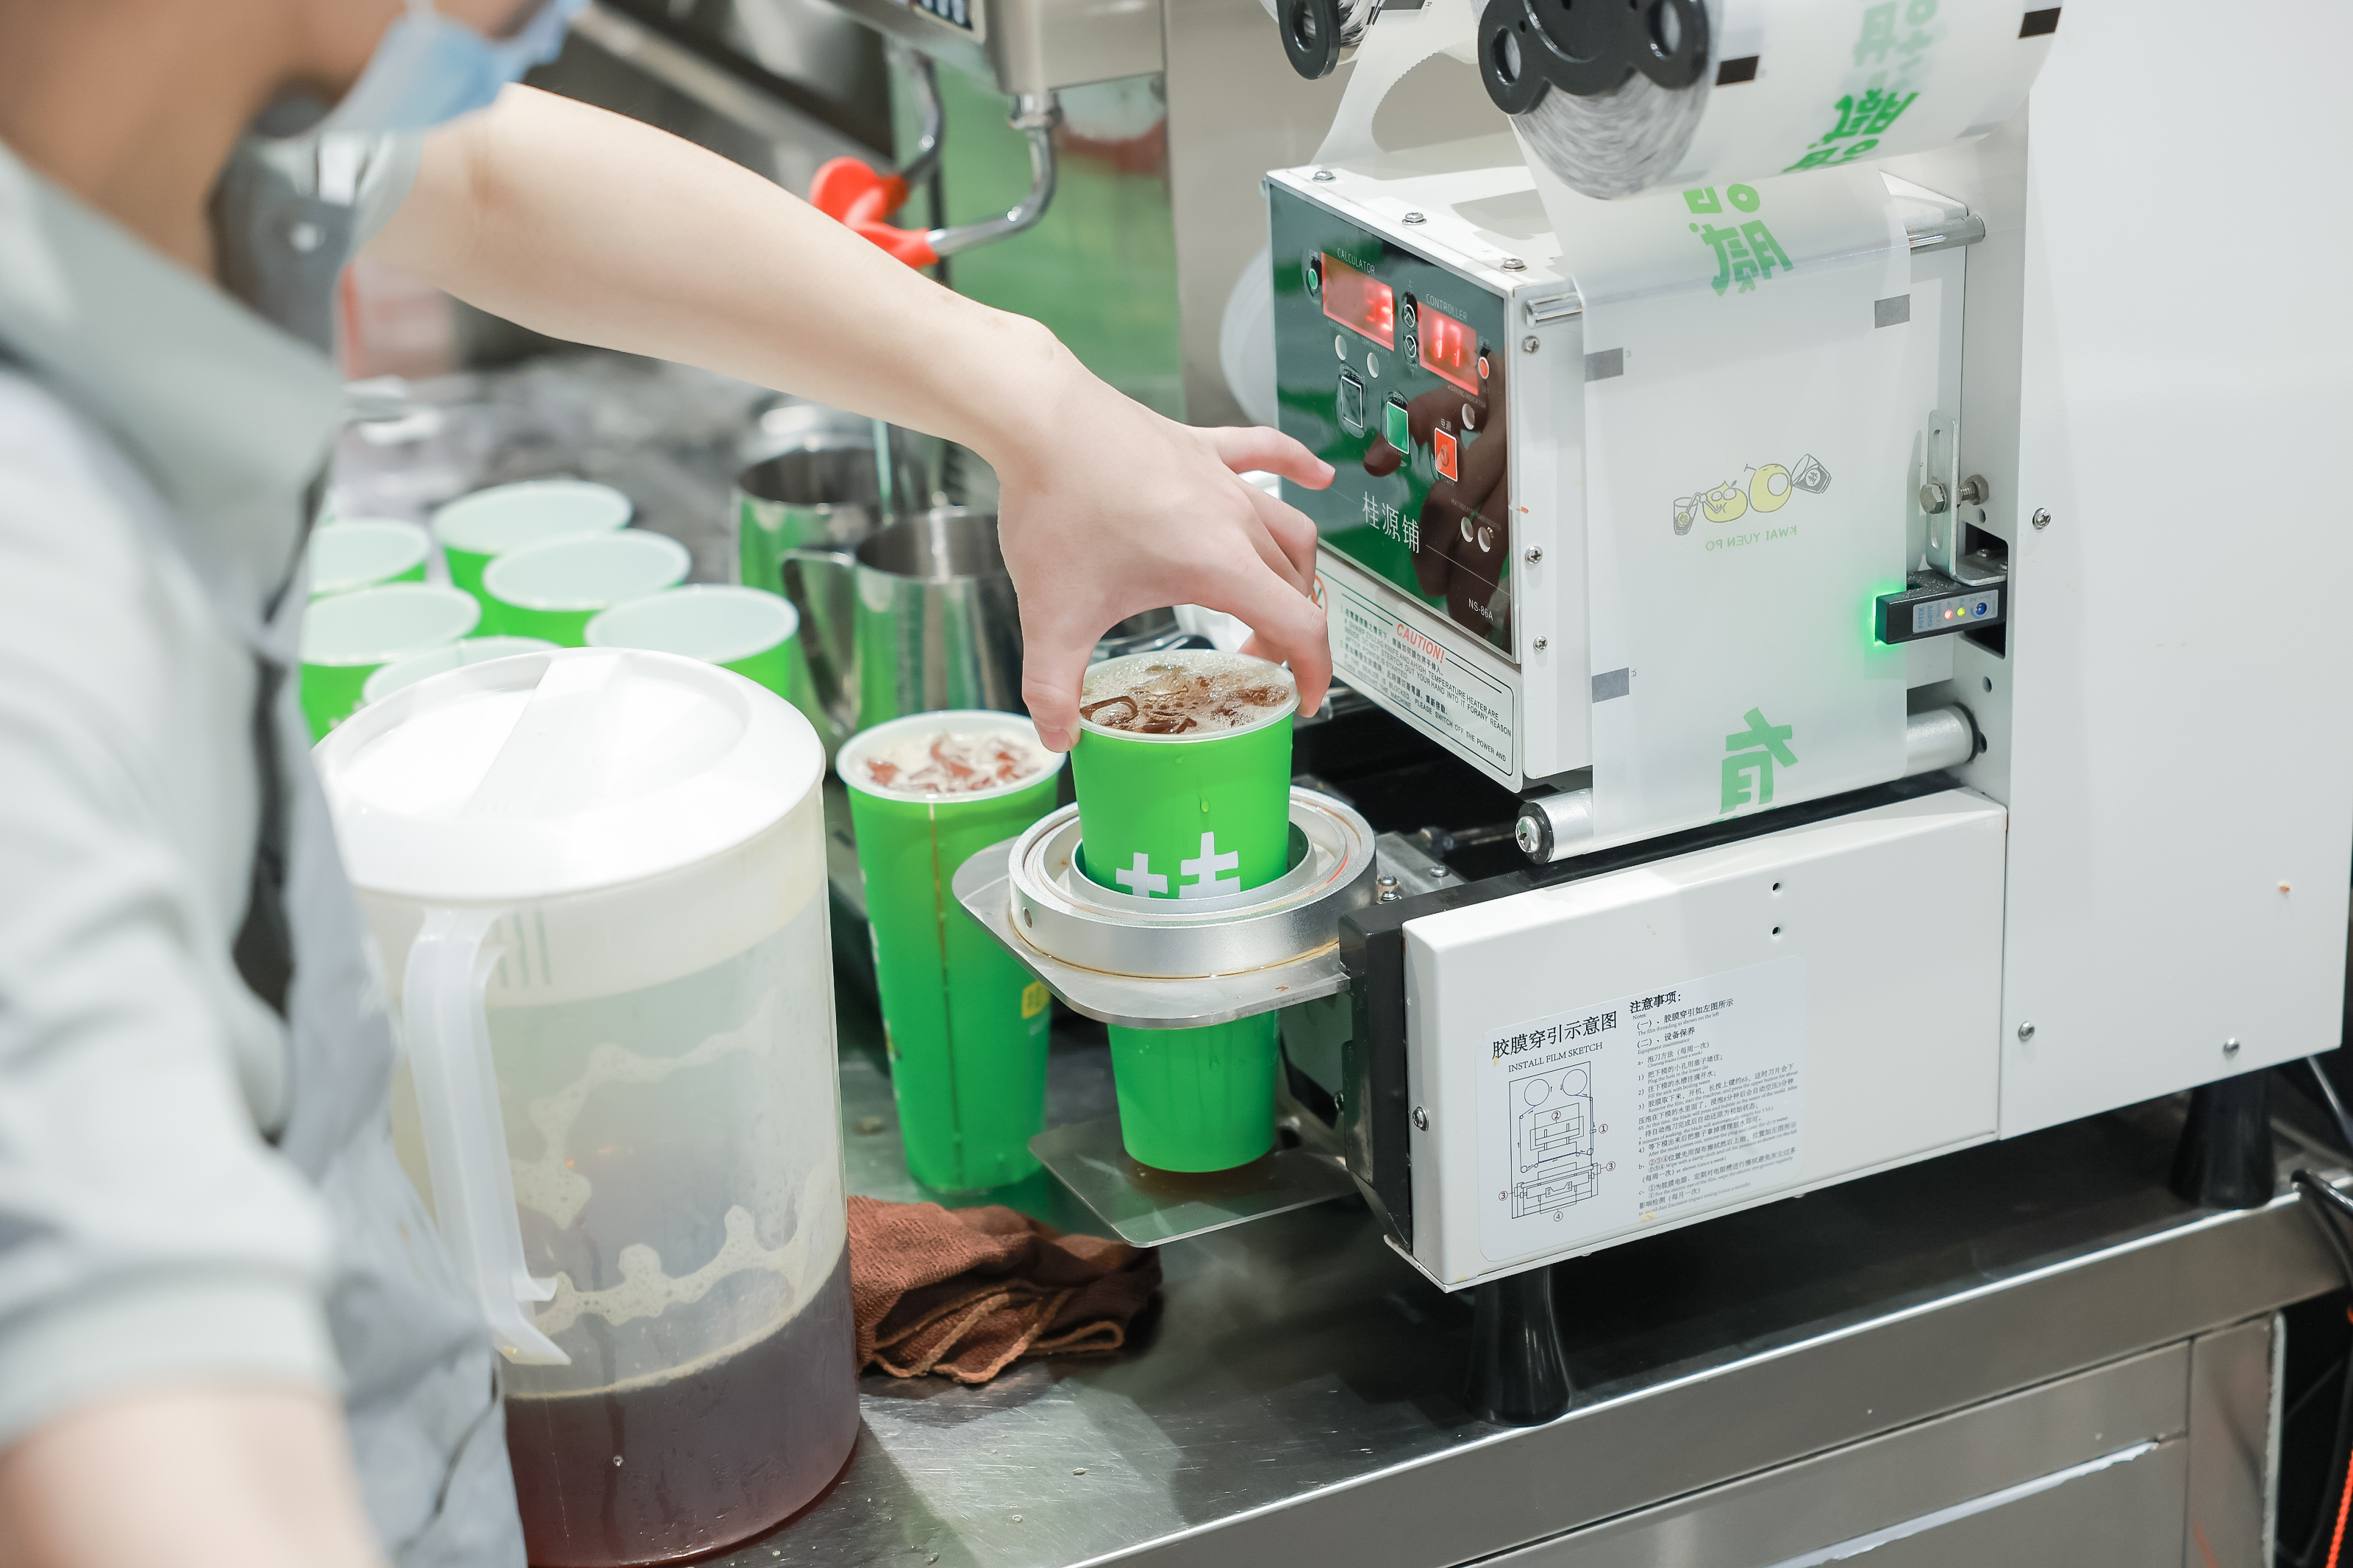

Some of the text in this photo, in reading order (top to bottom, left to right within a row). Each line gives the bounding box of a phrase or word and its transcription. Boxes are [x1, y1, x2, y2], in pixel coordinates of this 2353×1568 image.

[1337, 248, 1376, 276] CALCULATOR
[1426, 293, 1468, 322] CONTROLLER
[1440, 418, 1452, 432] 电源
[1362, 491, 1421, 554] 桂源铺
[1468, 597, 1495, 622] NS-86A
[1362, 645, 1379, 662] POWER
[1396, 623, 1445, 664] CAUTION!
[1349, 620, 1365, 637] SHARP
[1365, 631, 1383, 649] ZIGZAG
[1384, 642, 1399, 659] KNIFE
[1399, 652, 1409, 665] AND
[1428, 670, 1465, 701] TEMPERATURE
[1369, 641, 1511, 737] NOT STERTCH OUT YOUR HAND INTO IT REASON
[1379, 683, 1388, 695] THE
[1390, 690, 1412, 710] MACHINE
[1415, 698, 1432, 715] PLEASE
[1435, 710, 1452, 728] SWITCH
[1454, 723, 1463, 735] OFF
[1465, 730, 1475, 742] THE
[1477, 737, 1494, 755] POWER
[1496, 749, 1506, 762] AND
[1629, 989, 1681, 1014] 注意事项：
[1492, 1010, 1618, 1059] 胶膜穿引示意图
[1656, 1022, 1677, 1032] threading
[1682, 1017, 1696, 1025] shown
[1507, 1042, 1603, 1073] INSTALL FILM SKETCH
[1638, 1037, 1690, 1056] Equipment maintenance
[1649, 1104, 1665, 1113] Remove
[1732, 1084, 1743, 1092] press
[1750, 1079, 1763, 1088] upper
[1763, 1075, 1778, 1084] button
[1683, 1081, 1698, 1091] boiling
[1700, 1108, 1710, 1116] press
[1642, 1136, 1659, 1144] minutes
[1666, 1160, 1677, 1168] Wipe
[1691, 1153, 1704, 1161] damp
